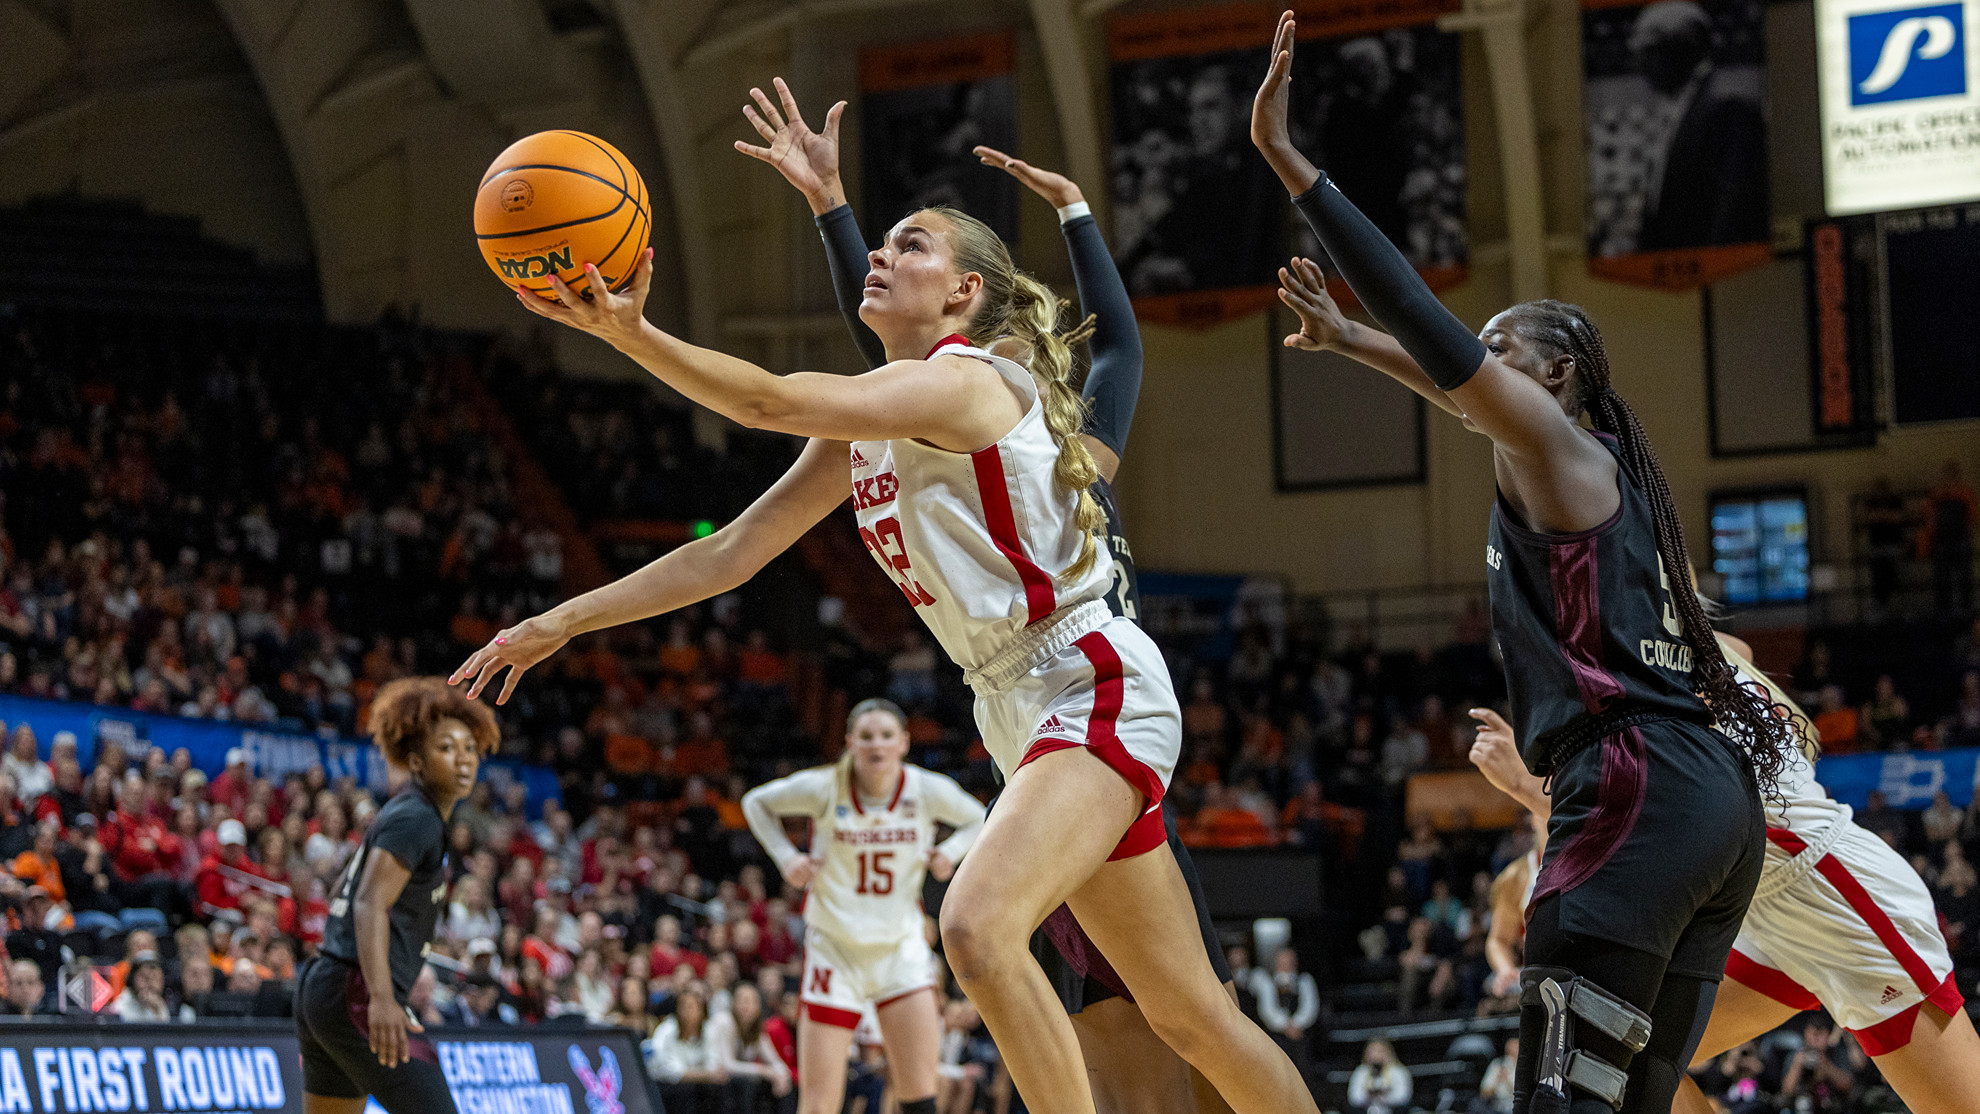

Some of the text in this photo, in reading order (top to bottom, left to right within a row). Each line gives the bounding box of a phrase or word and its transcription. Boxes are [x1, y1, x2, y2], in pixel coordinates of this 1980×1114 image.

[495, 246, 574, 279] NCAA
[1640, 639, 1695, 673] COULIB
[1037, 726, 1066, 735] adidas
[856, 851, 896, 896] 15
[809, 967, 833, 996] N
[437, 1040, 541, 1084] EASTERN
[0, 1045, 287, 1113] A FIRST ROUND
[450, 1081, 576, 1114] ASHINGTON
